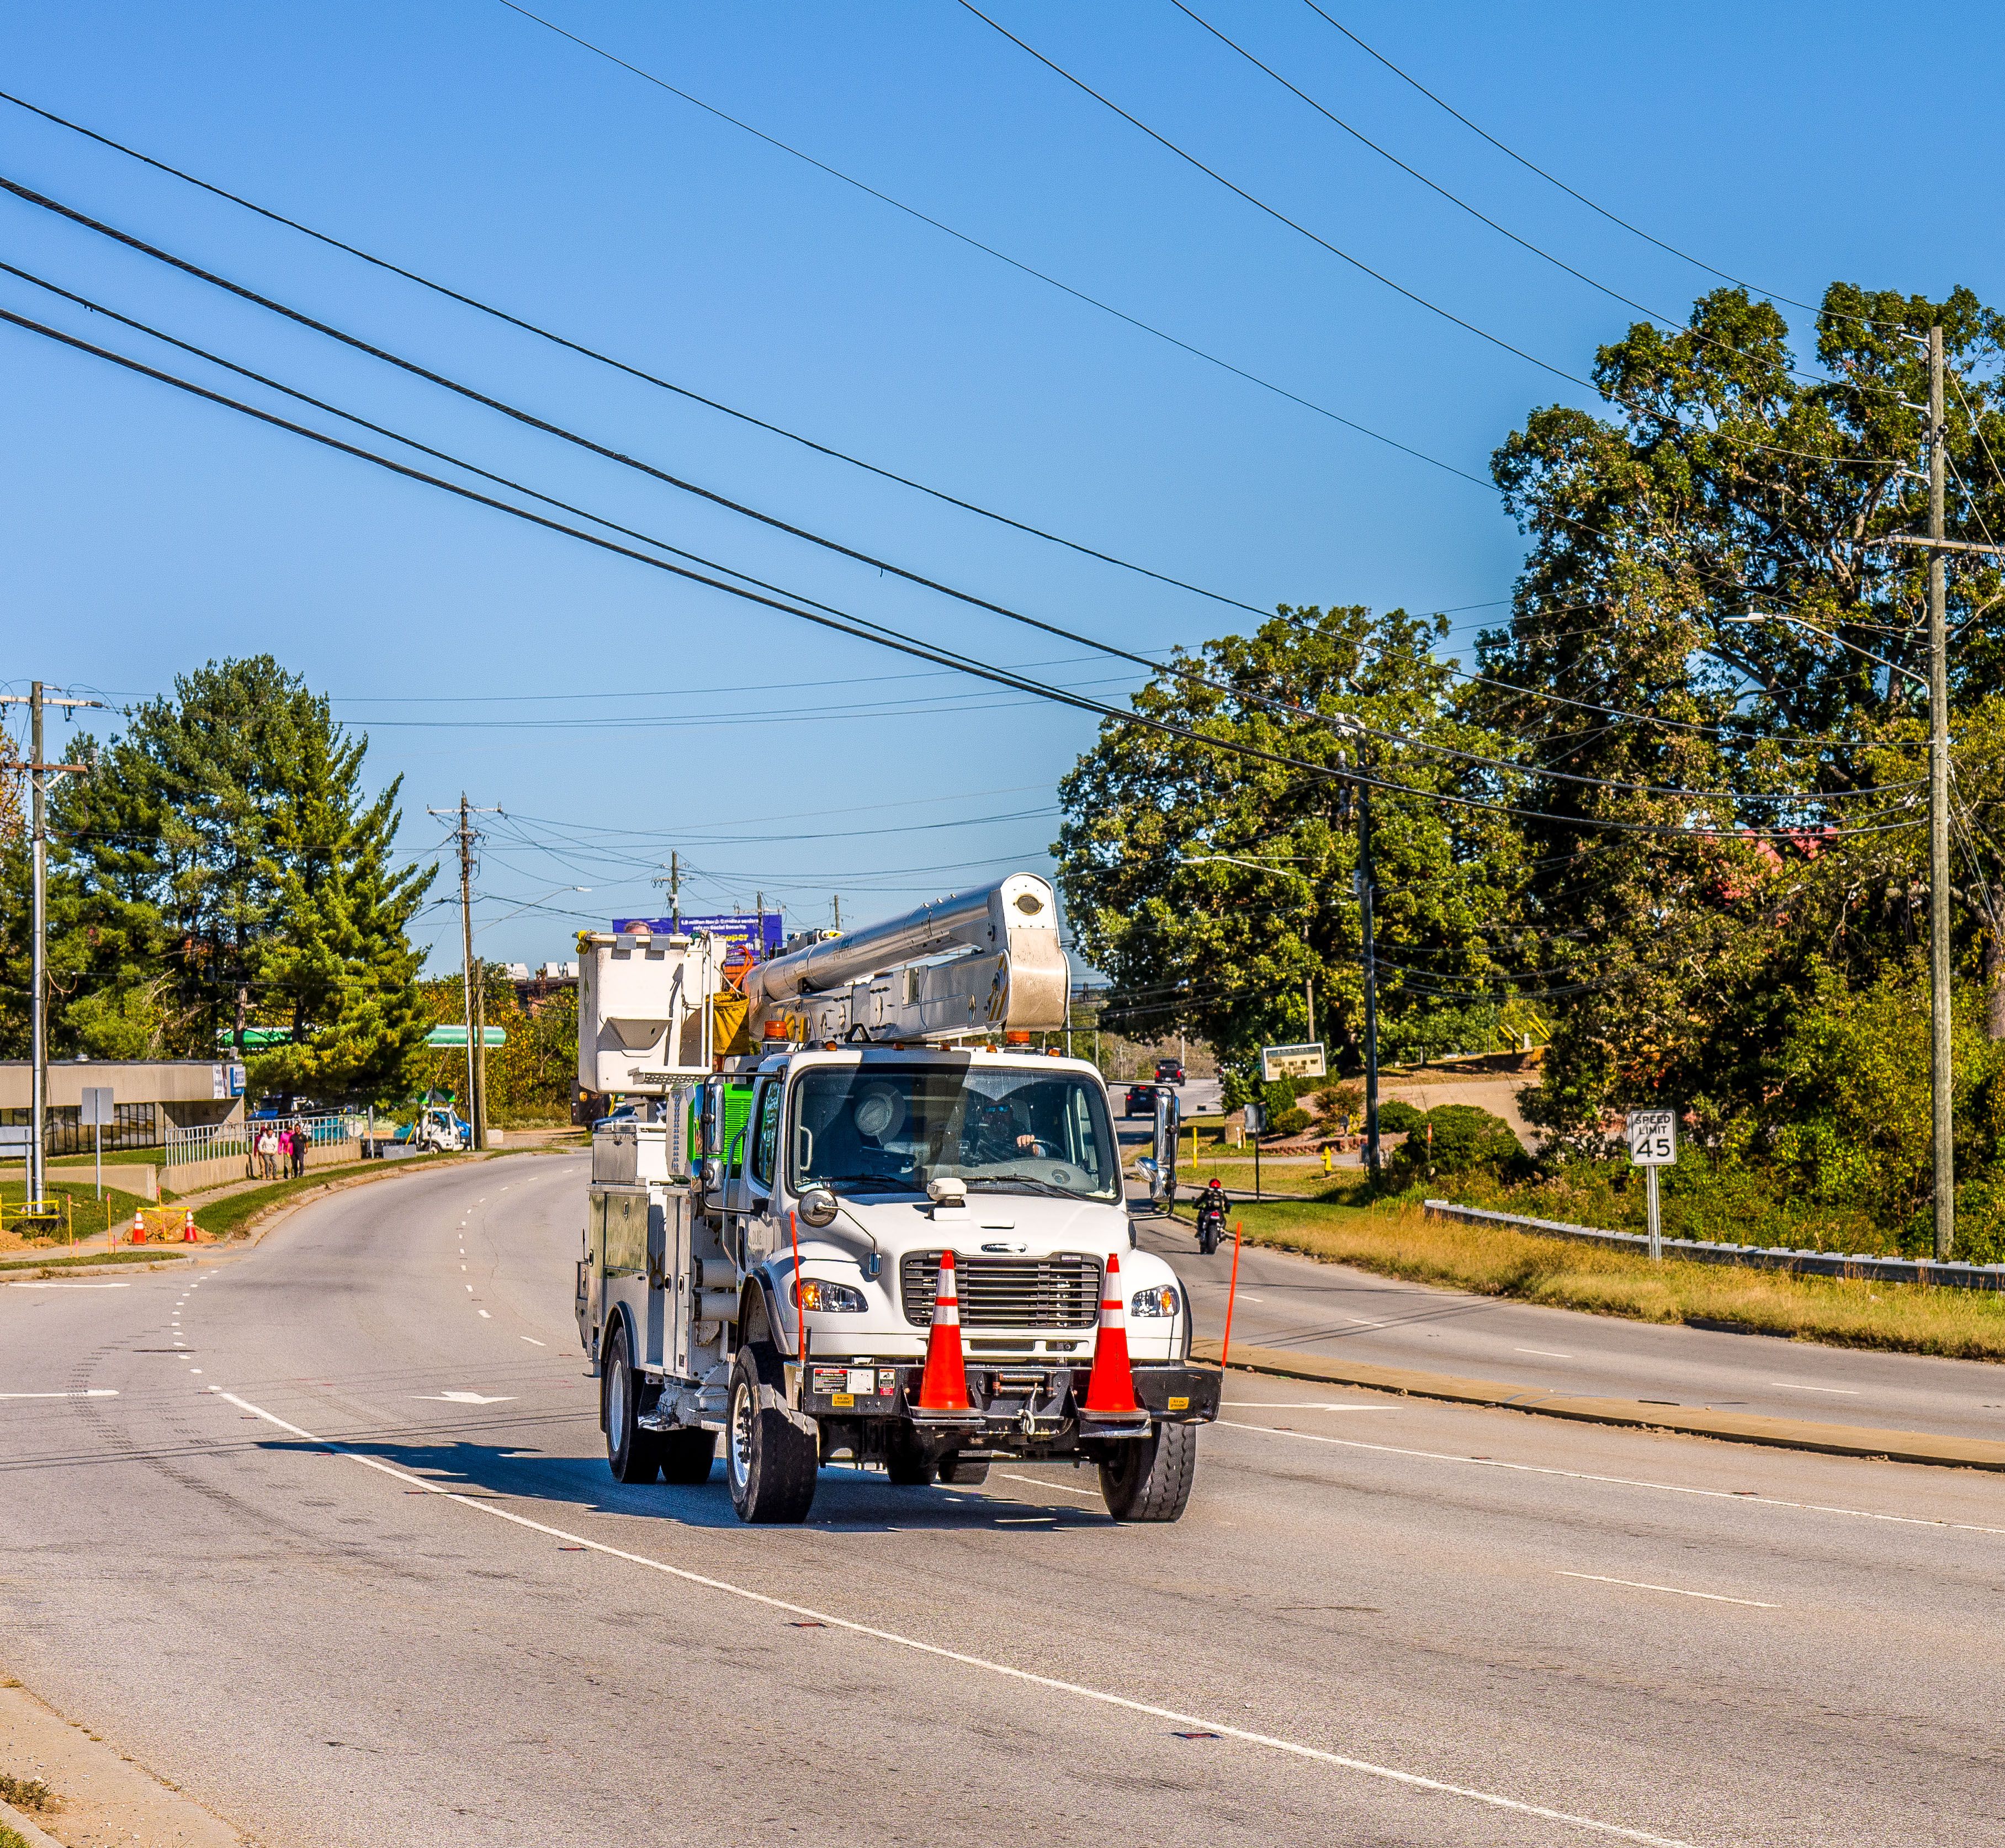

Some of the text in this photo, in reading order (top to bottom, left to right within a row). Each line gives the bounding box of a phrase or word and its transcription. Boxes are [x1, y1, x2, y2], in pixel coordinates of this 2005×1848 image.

[1634, 1115, 1670, 1124] SPEED
[1639, 1126, 1667, 1135] LIMIT
[1636, 1139, 1670, 1157] 45
